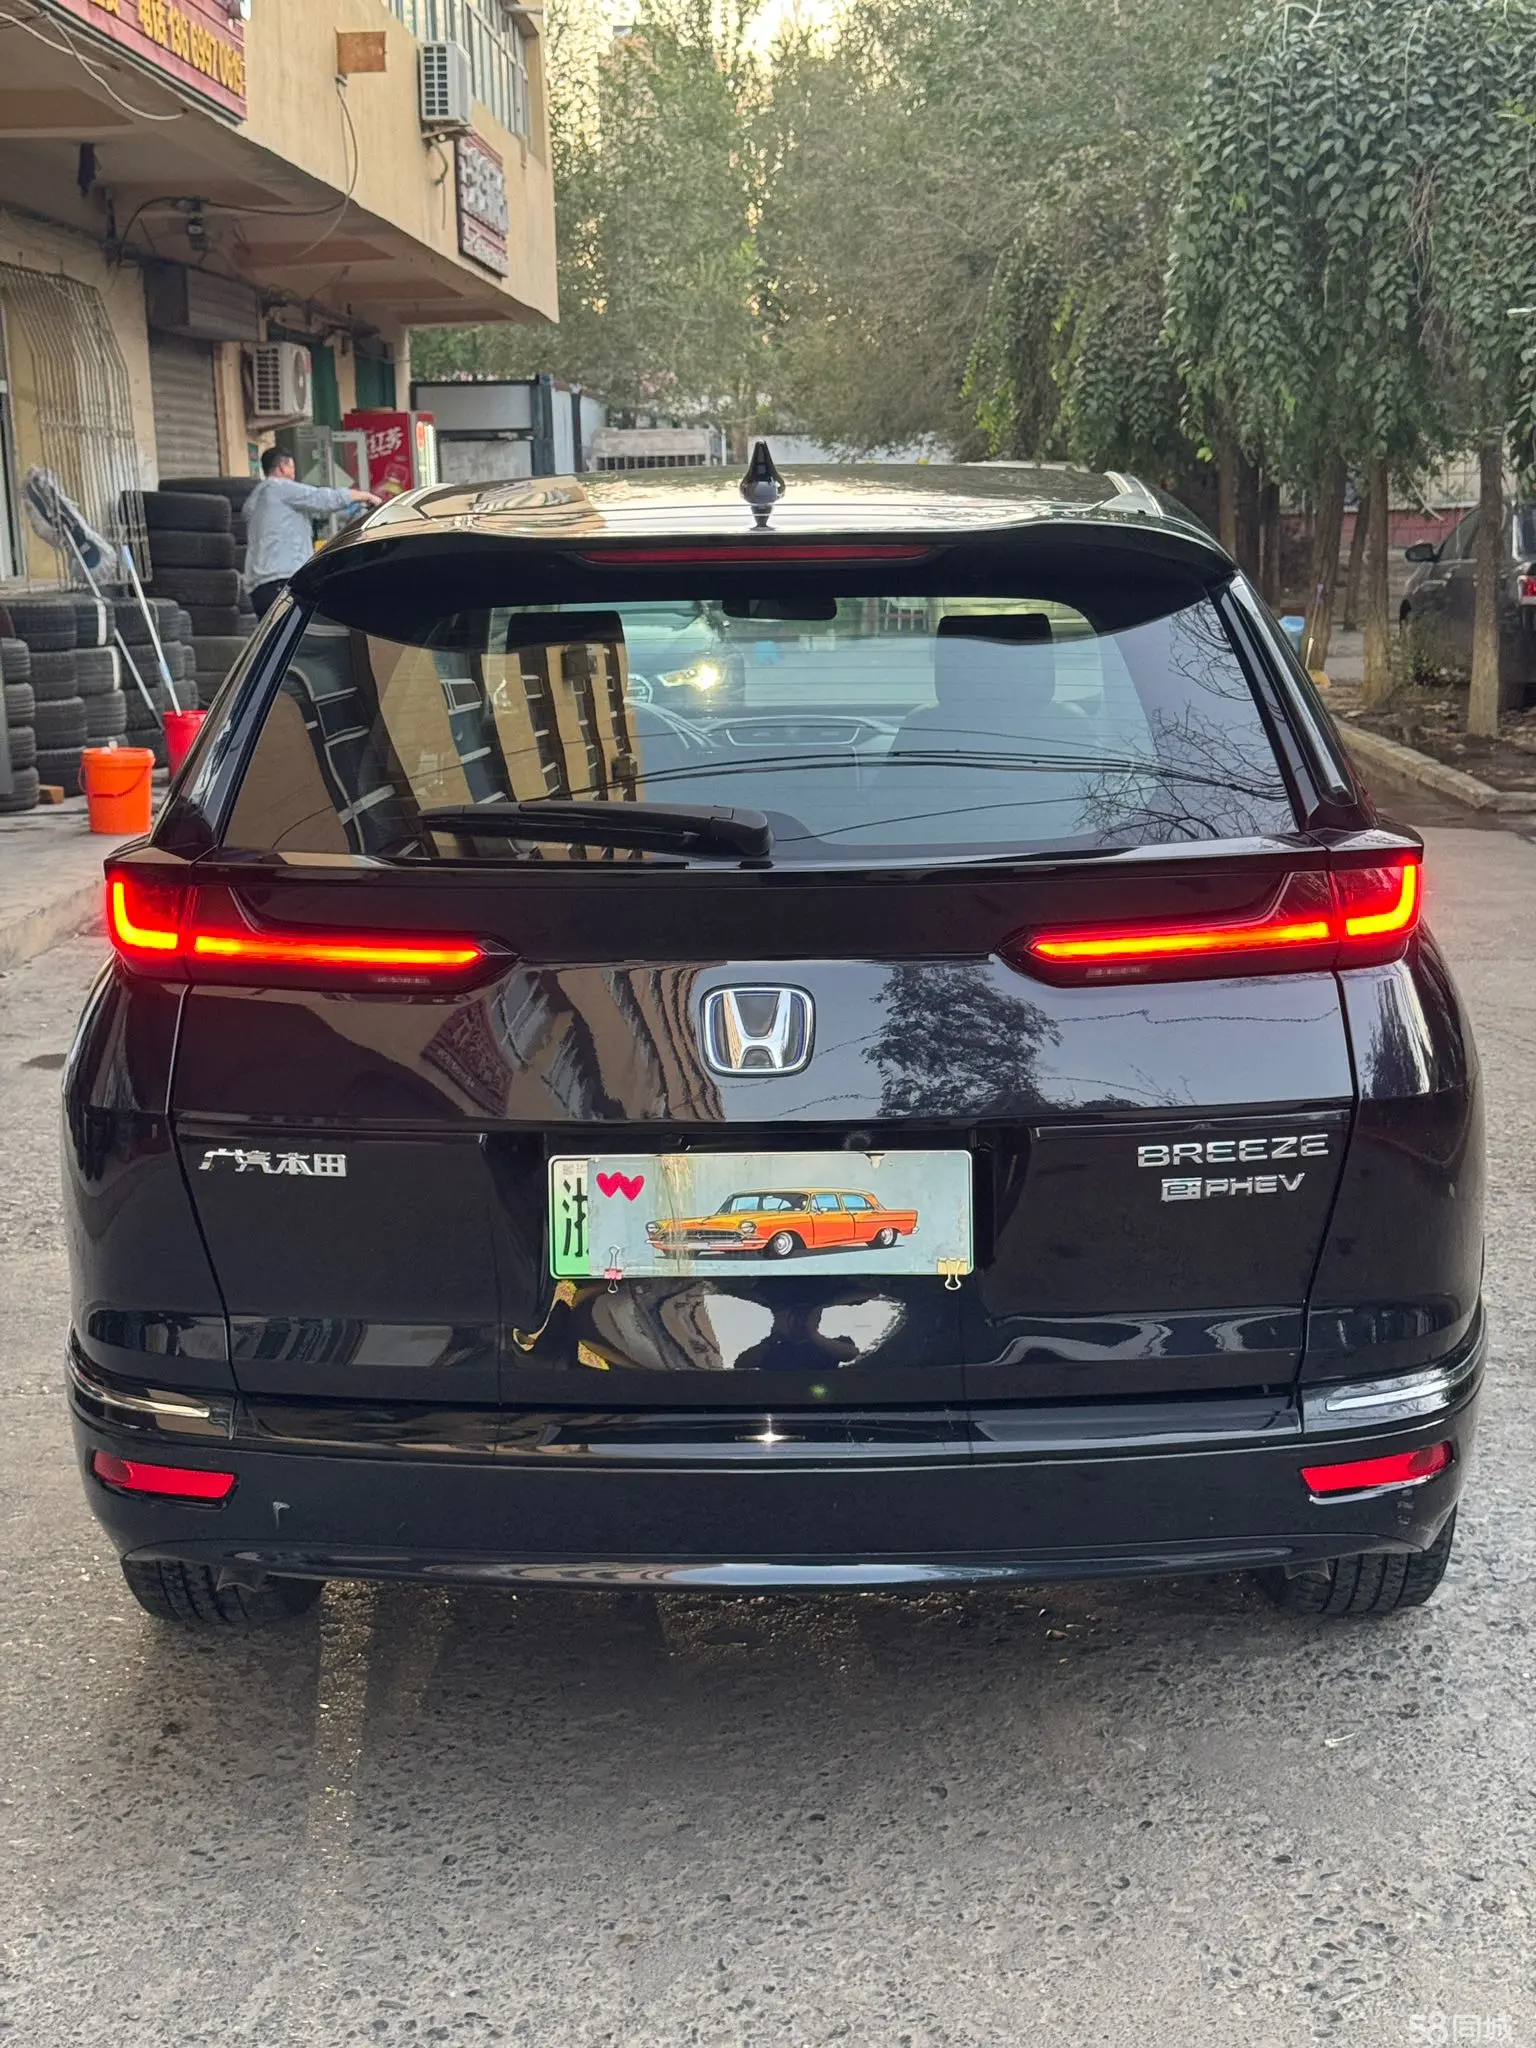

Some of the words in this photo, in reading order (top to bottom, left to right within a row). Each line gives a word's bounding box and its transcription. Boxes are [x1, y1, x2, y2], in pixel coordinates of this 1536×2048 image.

[199, 1148, 347, 1177] 广汽本田
[1137, 1133, 1329, 1168] BREEZE
